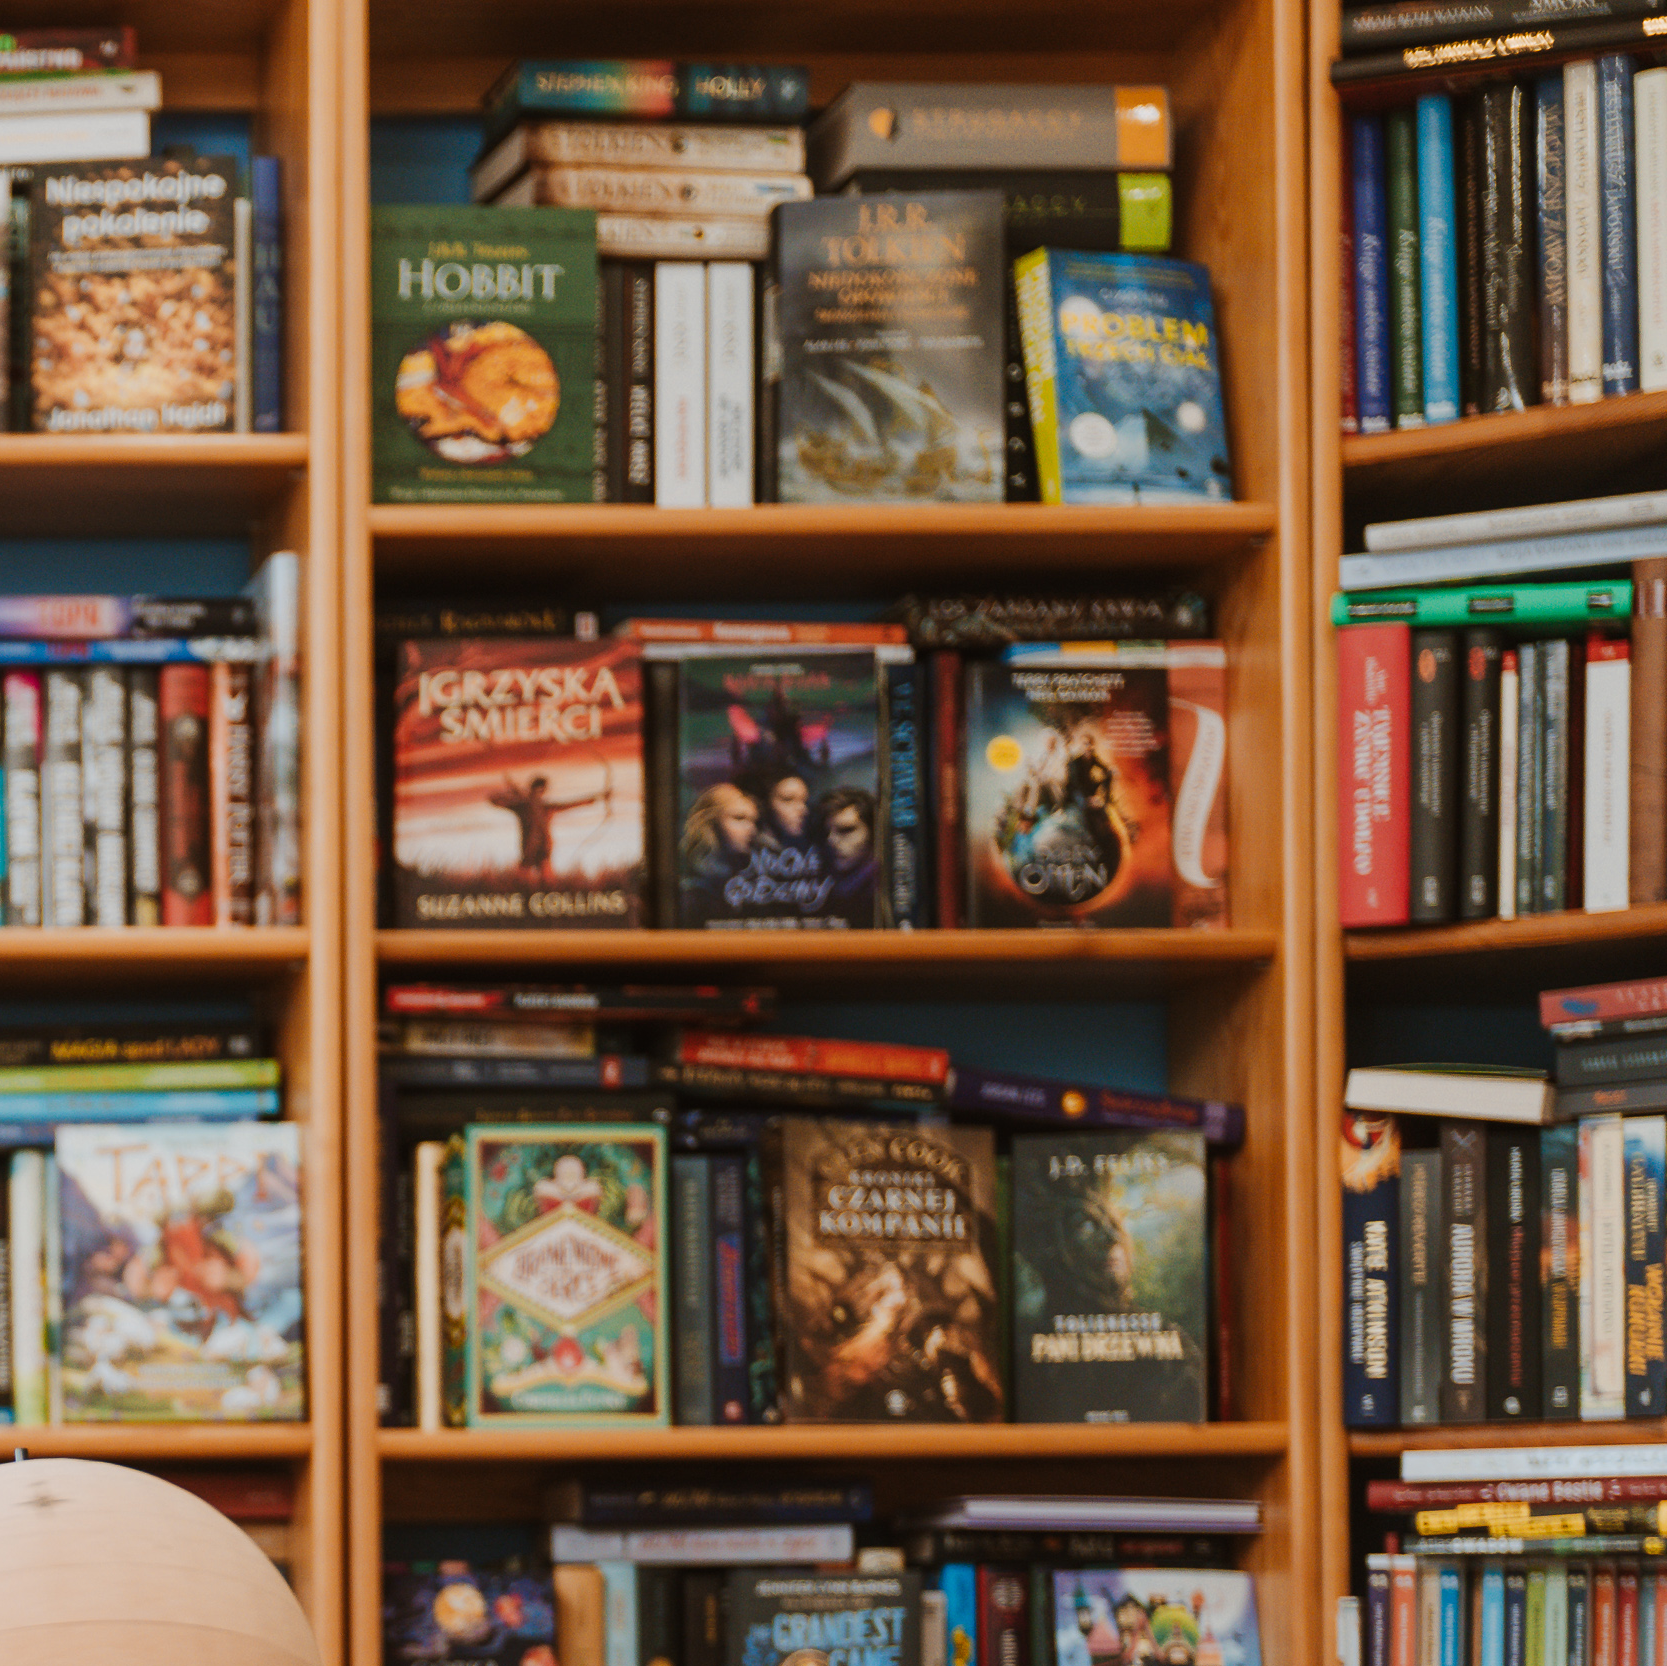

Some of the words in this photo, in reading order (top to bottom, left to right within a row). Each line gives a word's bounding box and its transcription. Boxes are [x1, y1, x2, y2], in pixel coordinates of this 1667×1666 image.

[46, 172, 227, 206] Niespokojne
[62, 206, 209, 246] pokolenie
[820, 234, 967, 268] TOLKIEN
[397, 257, 566, 301] HOBBIT
[1060, 312, 1210, 349] PROBLEM
[417, 666, 624, 714] IGRZYSKA
[439, 702, 603, 742] ŚMIERCI
[417, 890, 524, 919] SUZANNE
[529, 888, 626, 918] COLLINS
[826, 1187, 956, 1212] CZARNEJ
[818, 1211, 968, 1239] KOMPANII
